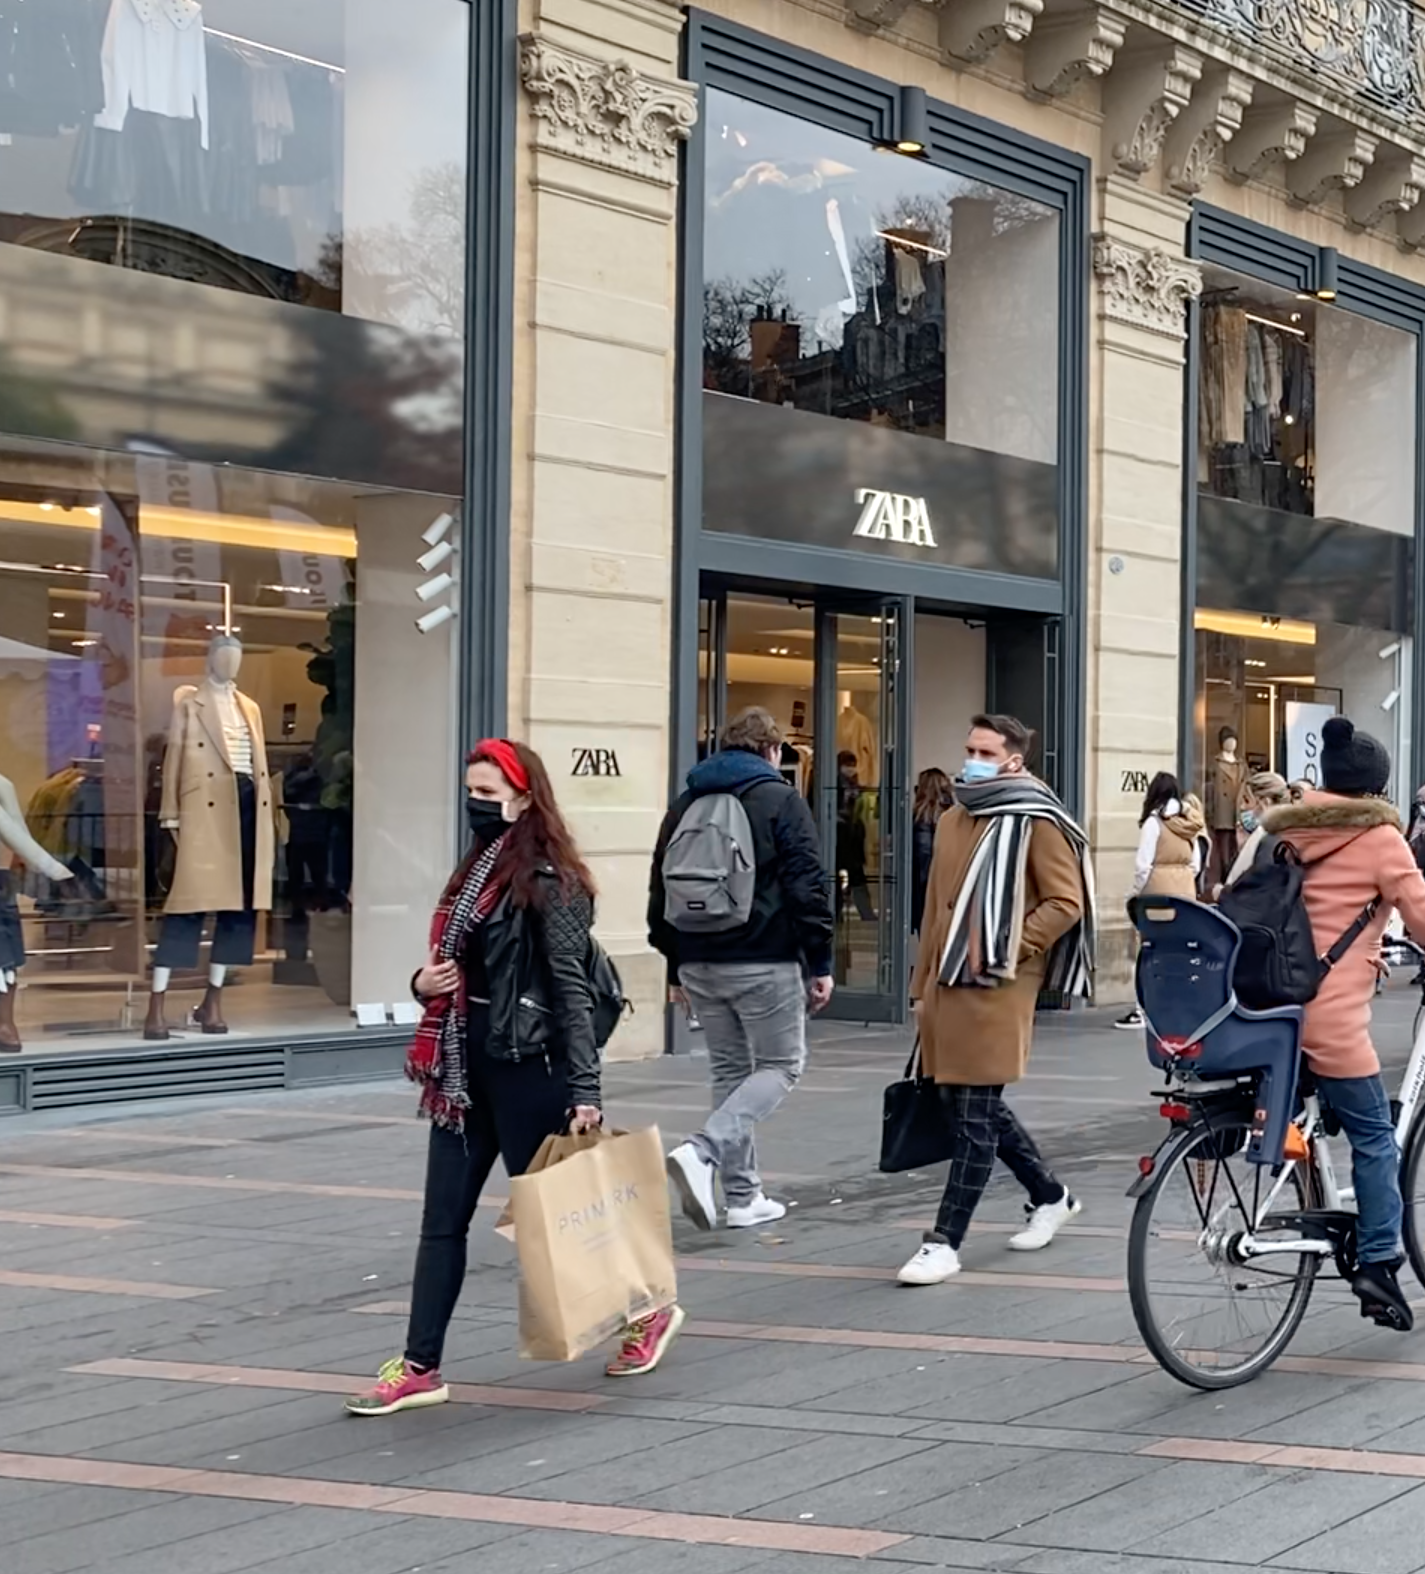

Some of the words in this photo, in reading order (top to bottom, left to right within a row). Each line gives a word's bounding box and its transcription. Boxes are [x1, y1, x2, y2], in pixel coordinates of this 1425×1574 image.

[852, 487, 938, 548] ZARA
[570, 747, 622, 777] ZARA
[558, 1182, 640, 1237] PRIMRK
